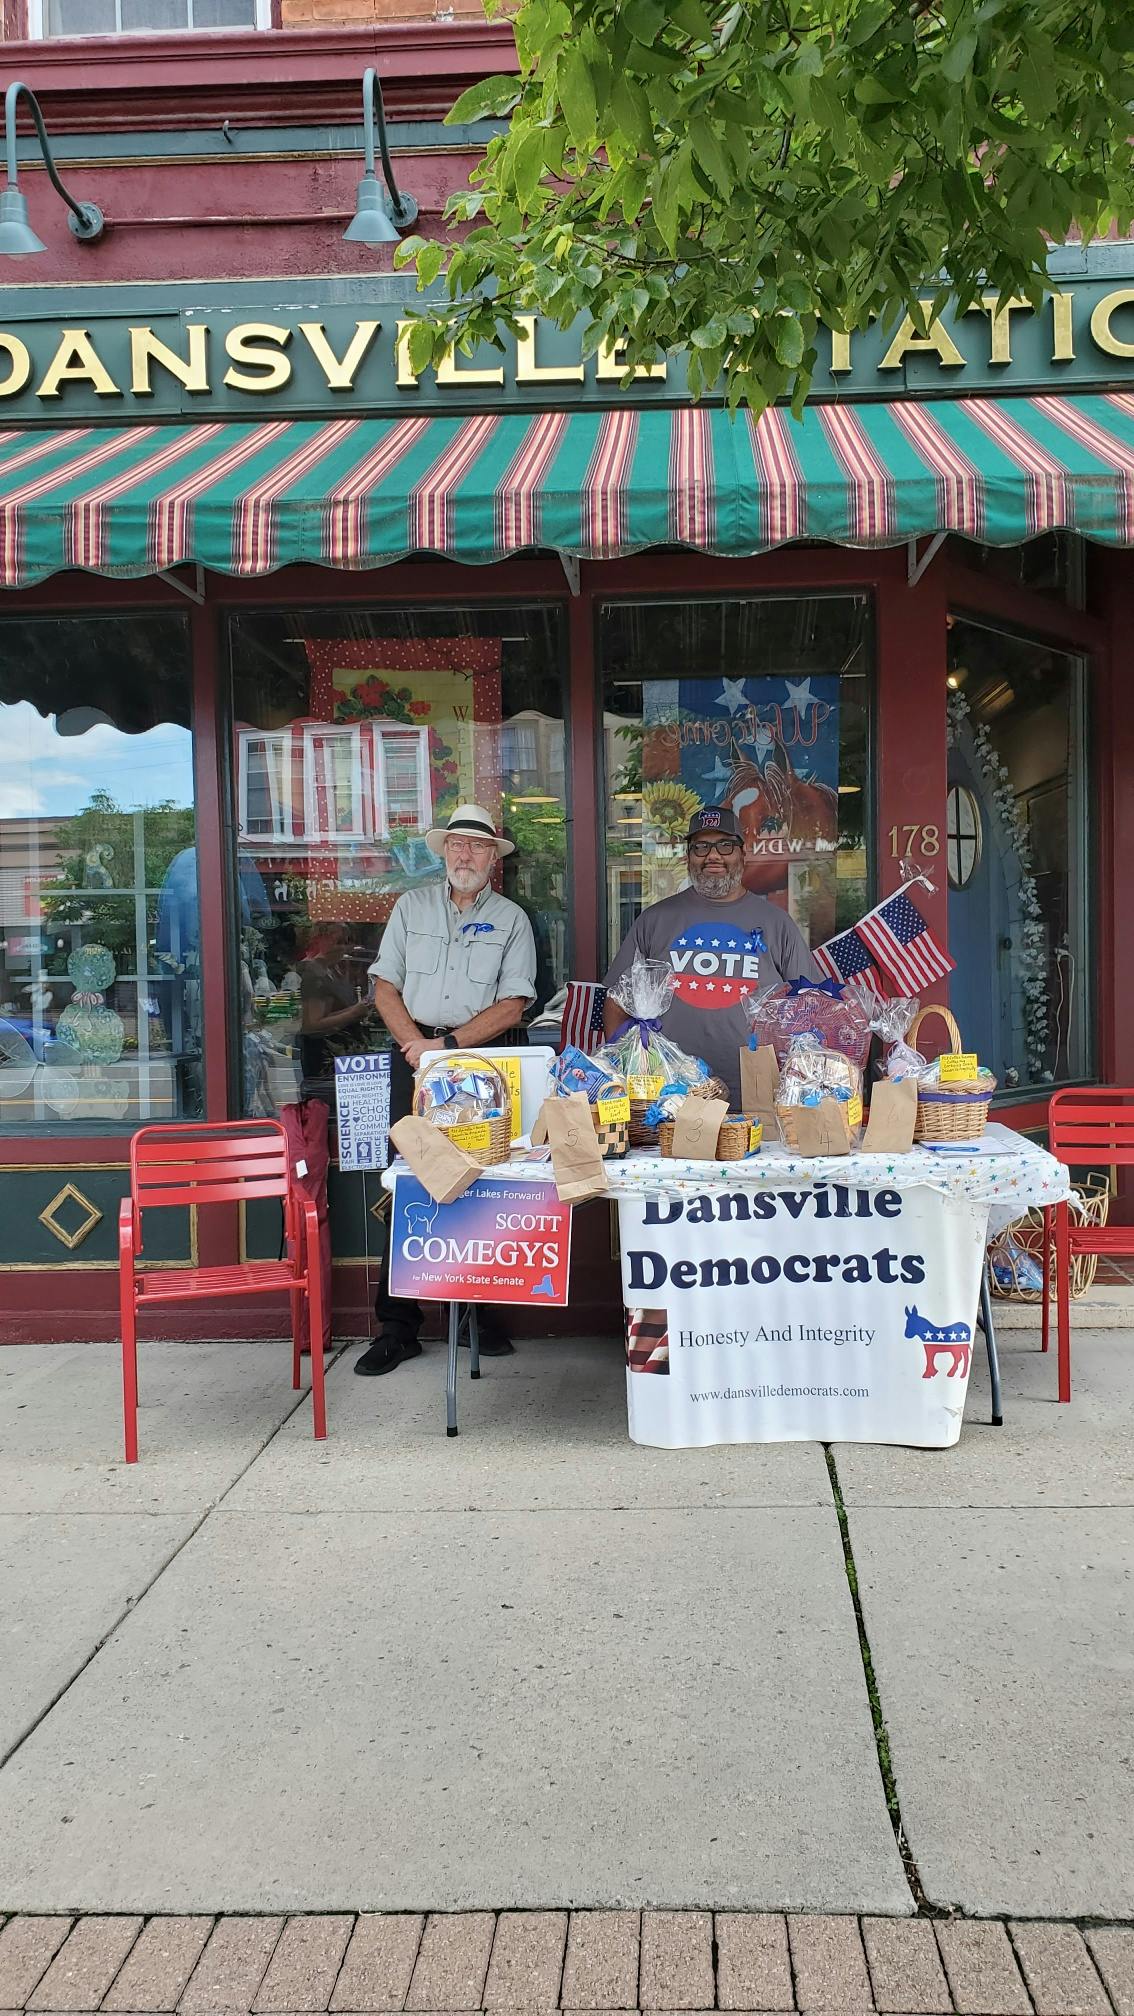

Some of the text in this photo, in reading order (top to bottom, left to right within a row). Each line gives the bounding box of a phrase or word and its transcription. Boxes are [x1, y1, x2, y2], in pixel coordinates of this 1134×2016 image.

[888, 824, 940, 858] 178
[669, 951, 759, 979] VOTE
[337, 1055, 390, 1073] VOTE
[353, 1098, 383, 1106] HEALTH
[340, 1101, 351, 1159] SCIENCE
[564, 1128, 579, 1147] 5
[686, 1118, 703, 1143] 3
[818, 1131, 832, 1157] 4
[476, 1189, 501, 1199] Lakes
[503, 1191, 545, 1201] Forward!
[642, 1183, 903, 1225] Dansville
[495, 1213, 562, 1232] SCOTT
[402, 1236, 559, 1268] COMEGYS
[421, 1272, 443, 1282] New
[445, 1273, 464, 1283] York
[466, 1275, 490, 1284] State
[492, 1276, 525, 1286] Senate
[627, 1247, 926, 1289] Democrats
[679, 1324, 876, 1348] Honesty And Integrity
[689, 1384, 869, 1403] www.dansvilledemocrats.com
